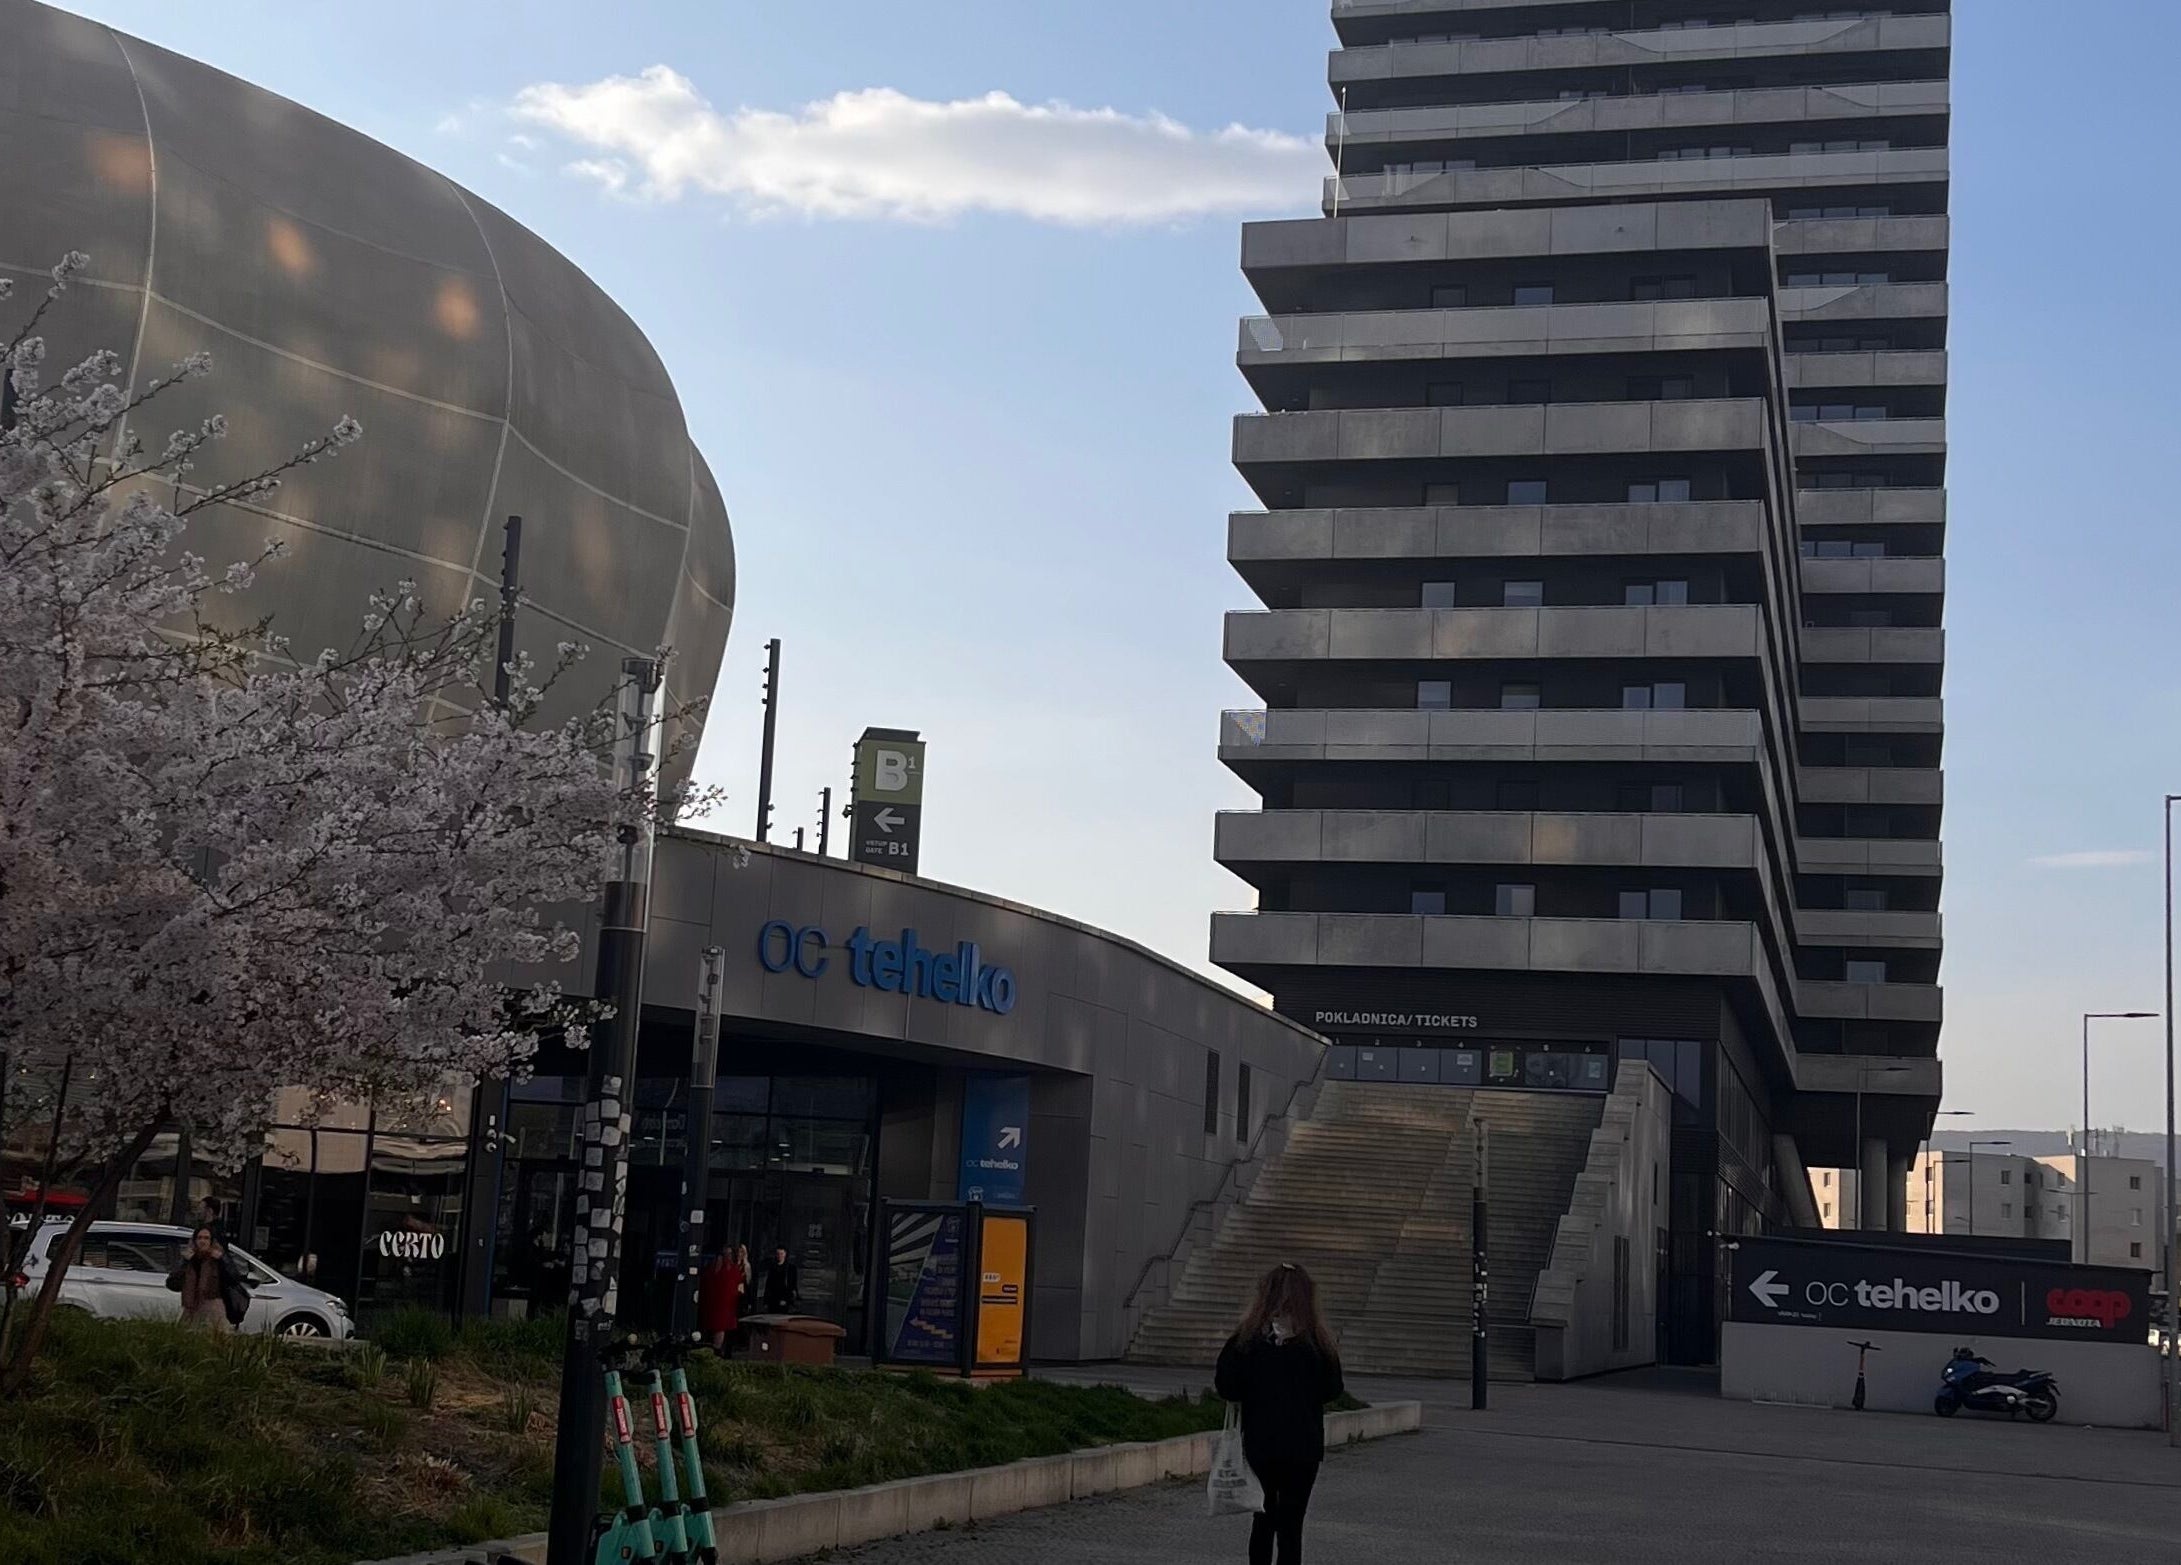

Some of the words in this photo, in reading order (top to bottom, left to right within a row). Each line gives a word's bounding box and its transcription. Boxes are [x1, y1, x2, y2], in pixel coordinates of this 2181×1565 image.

[888, 841, 910, 856] B1
[759, 919, 832, 979] OC
[849, 927, 1016, 1014] tehelko
[980, 1158, 1019, 1170] tehelko
[1805, 1281, 1849, 1307] OC
[1854, 1278, 2000, 1314] tehelko
[2046, 1288, 2132, 1329] coop
